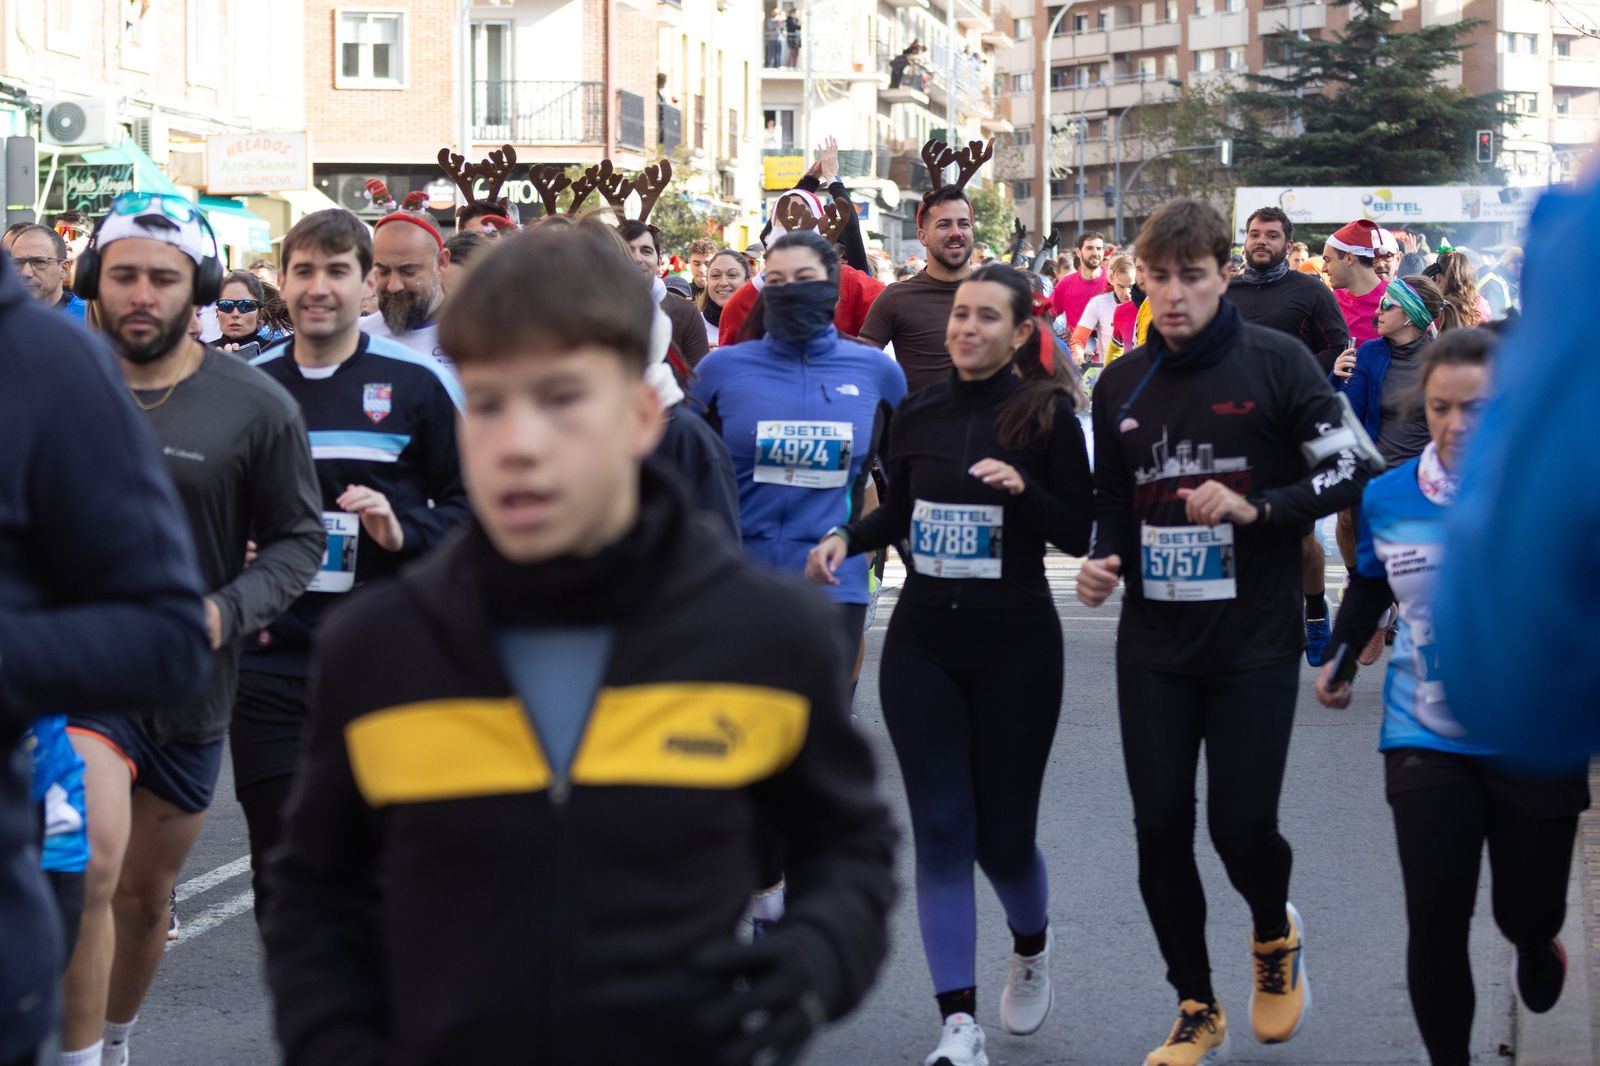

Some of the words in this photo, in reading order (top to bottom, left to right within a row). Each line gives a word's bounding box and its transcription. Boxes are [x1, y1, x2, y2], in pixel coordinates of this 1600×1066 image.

[225, 138, 292, 159] HELADOS
[1373, 202, 1423, 212] SETEL
[783, 425, 842, 437] SETEL
[768, 439, 830, 467] 4924
[931, 508, 993, 523] SETEL
[919, 522, 979, 556] 3788
[1158, 530, 1223, 545] SETEL
[1150, 546, 1209, 577] 5757
